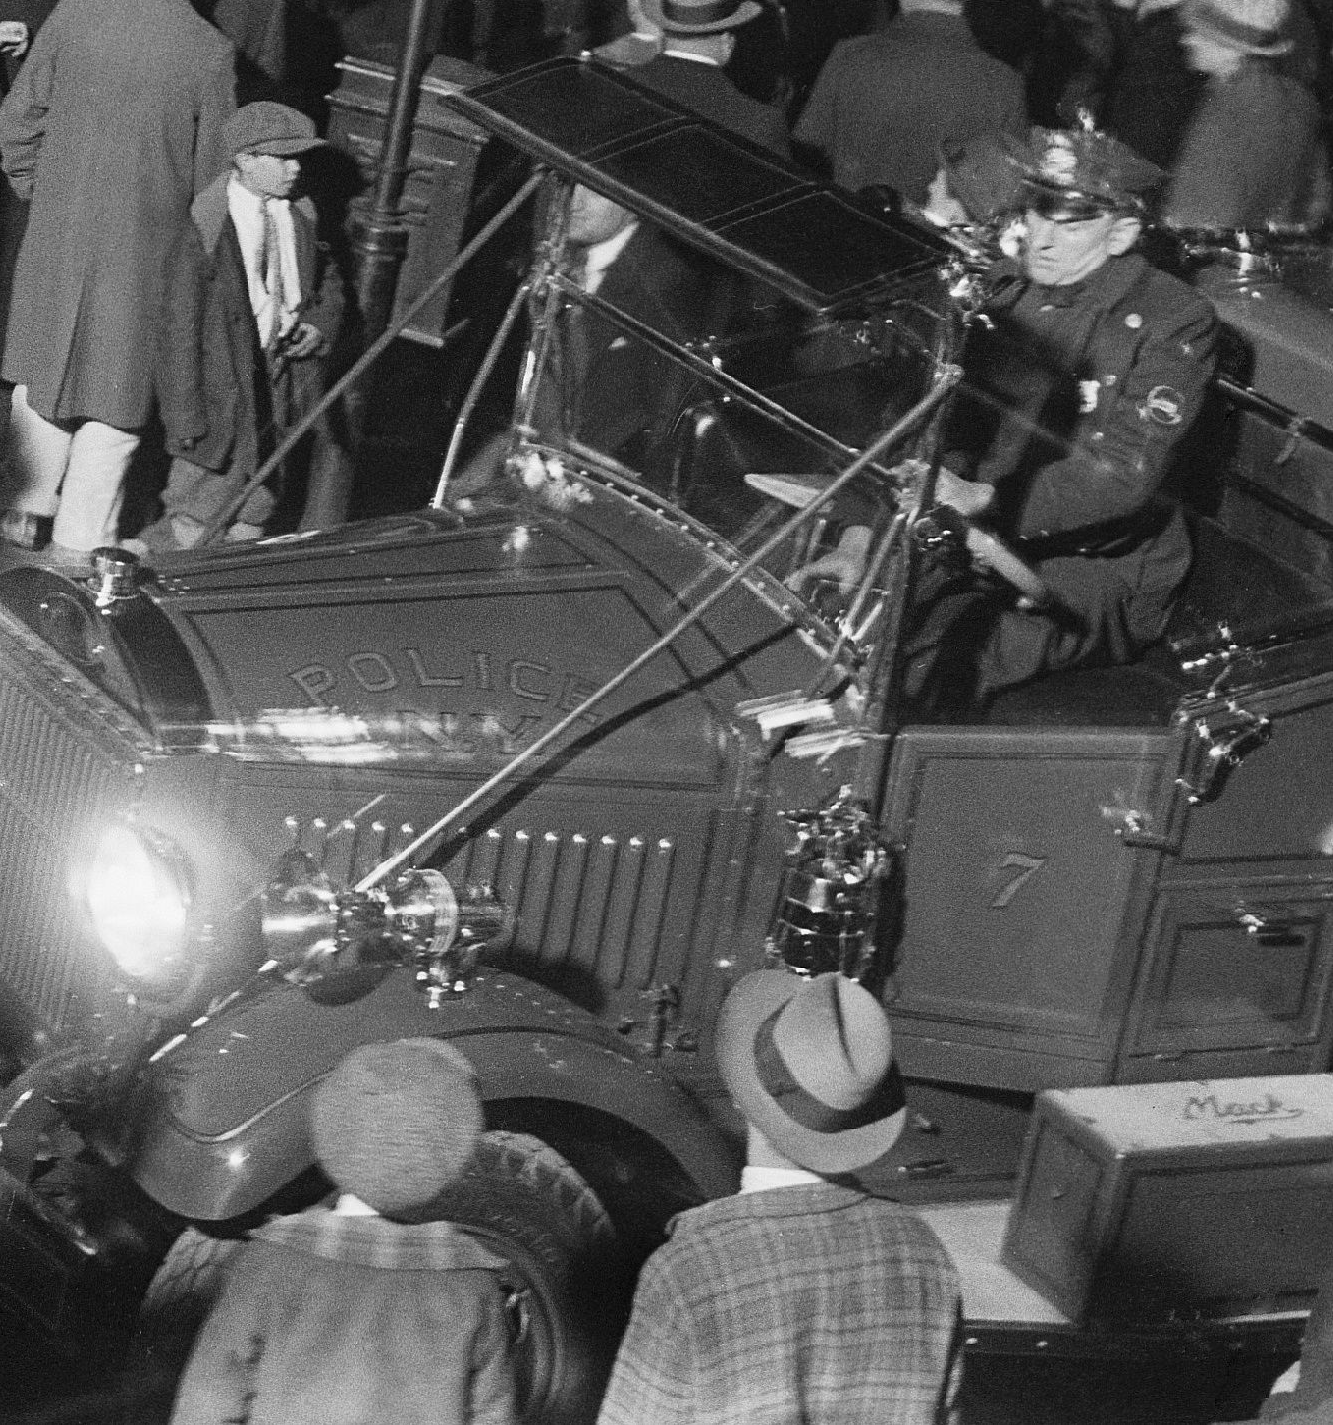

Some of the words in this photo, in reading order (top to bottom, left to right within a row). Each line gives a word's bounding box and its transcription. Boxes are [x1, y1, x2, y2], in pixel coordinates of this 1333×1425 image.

[290, 647, 605, 723] POLICE
[991, 851, 1046, 909] 7
[1184, 1093, 1305, 1126] Mack
